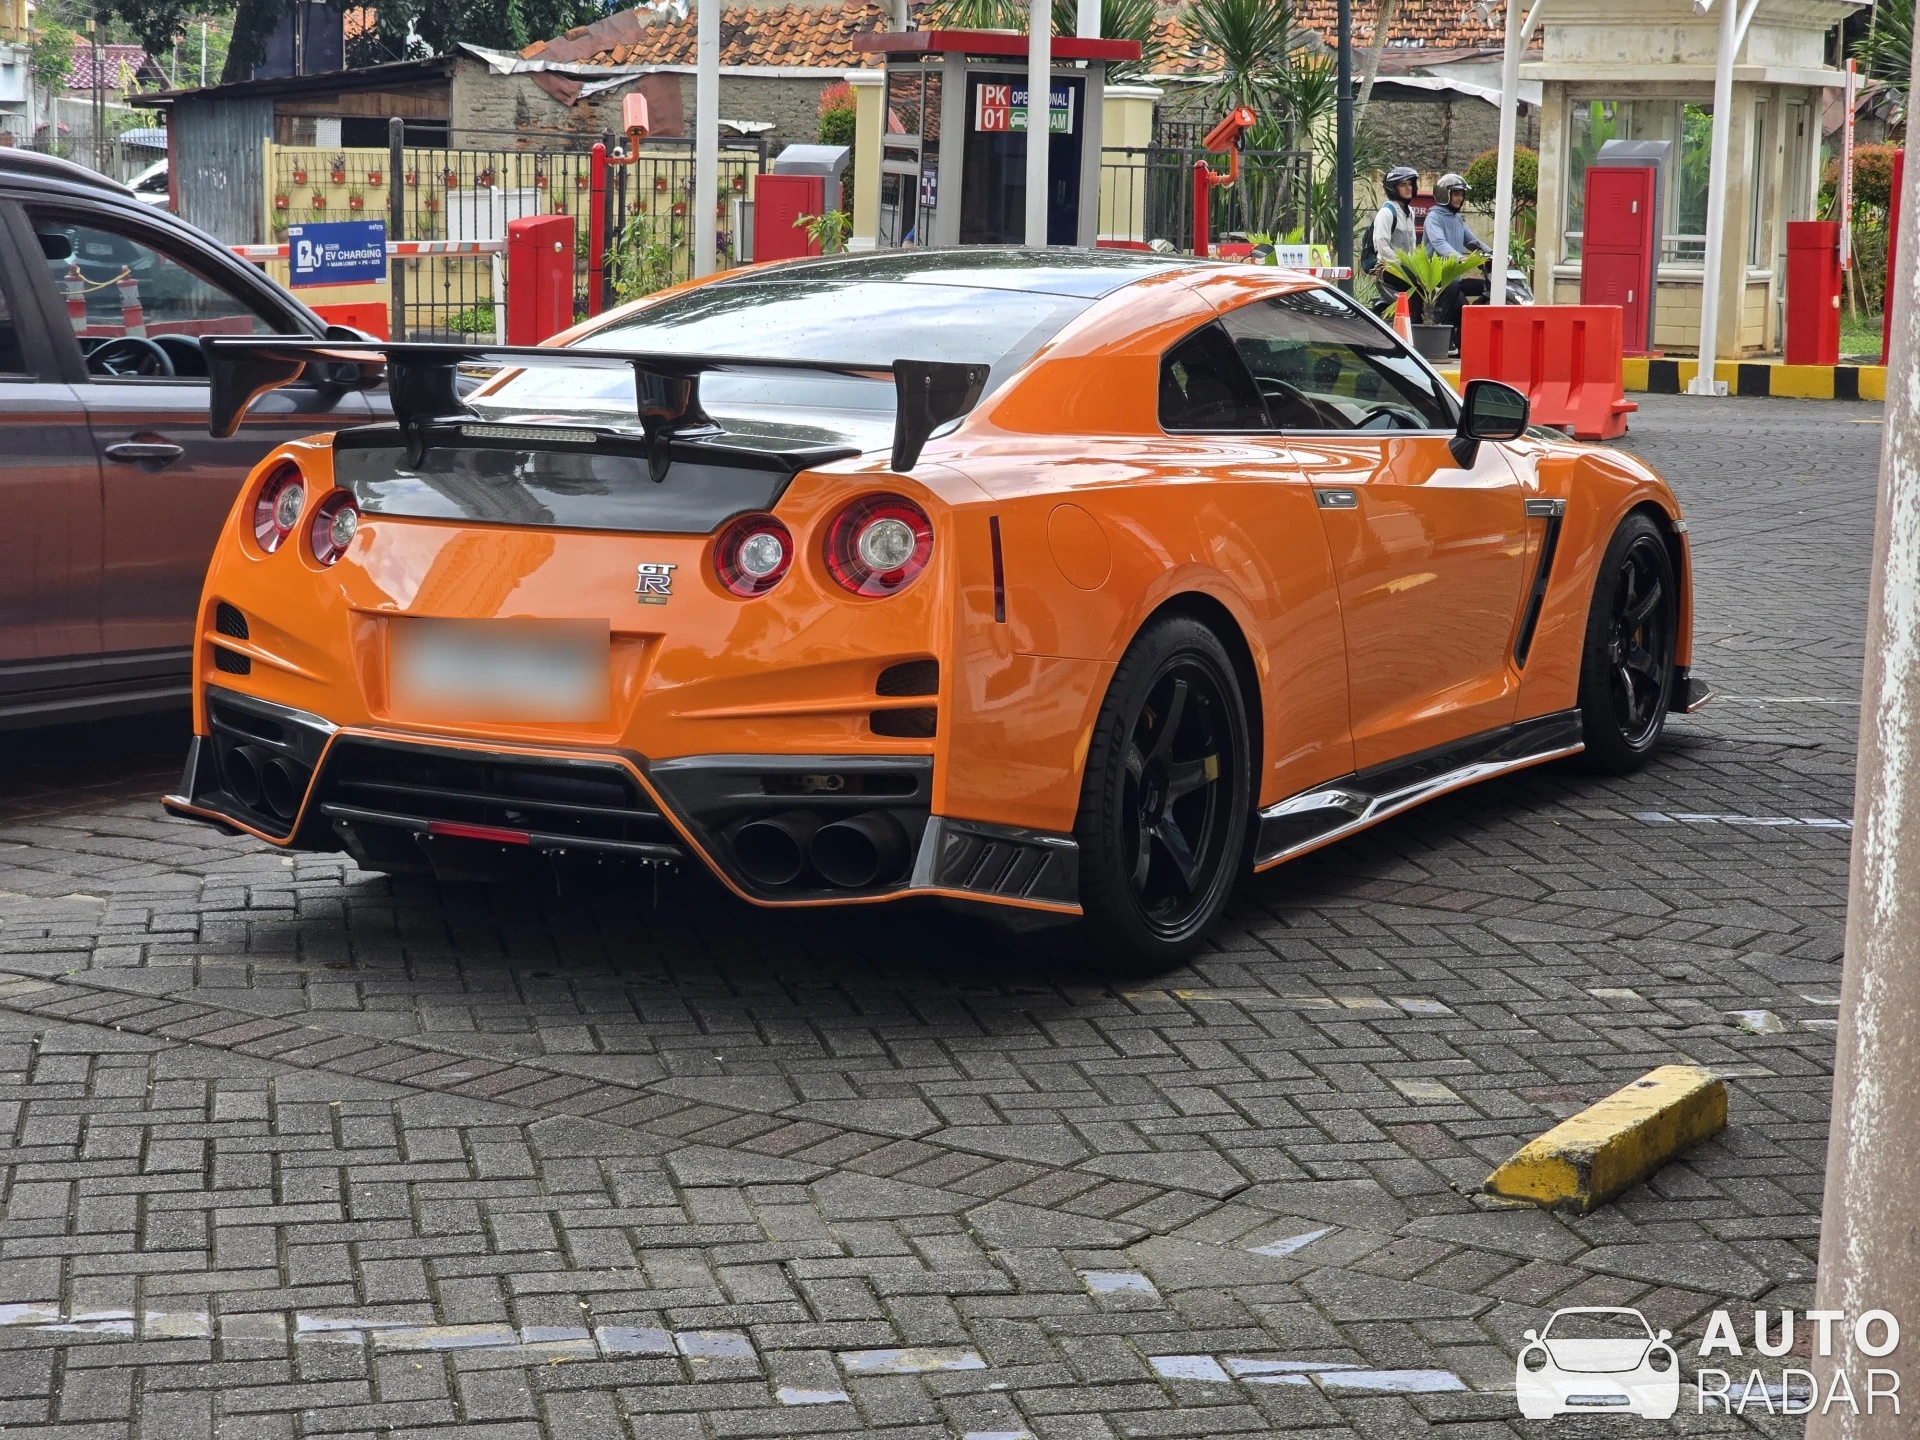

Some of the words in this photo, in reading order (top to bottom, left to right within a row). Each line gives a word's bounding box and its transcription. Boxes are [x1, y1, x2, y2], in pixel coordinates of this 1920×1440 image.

[985, 86, 1006, 105] PK
[984, 109, 1004, 129] 01
[325, 251, 336, 261] EV
[338, 249, 381, 260] CHARGING
